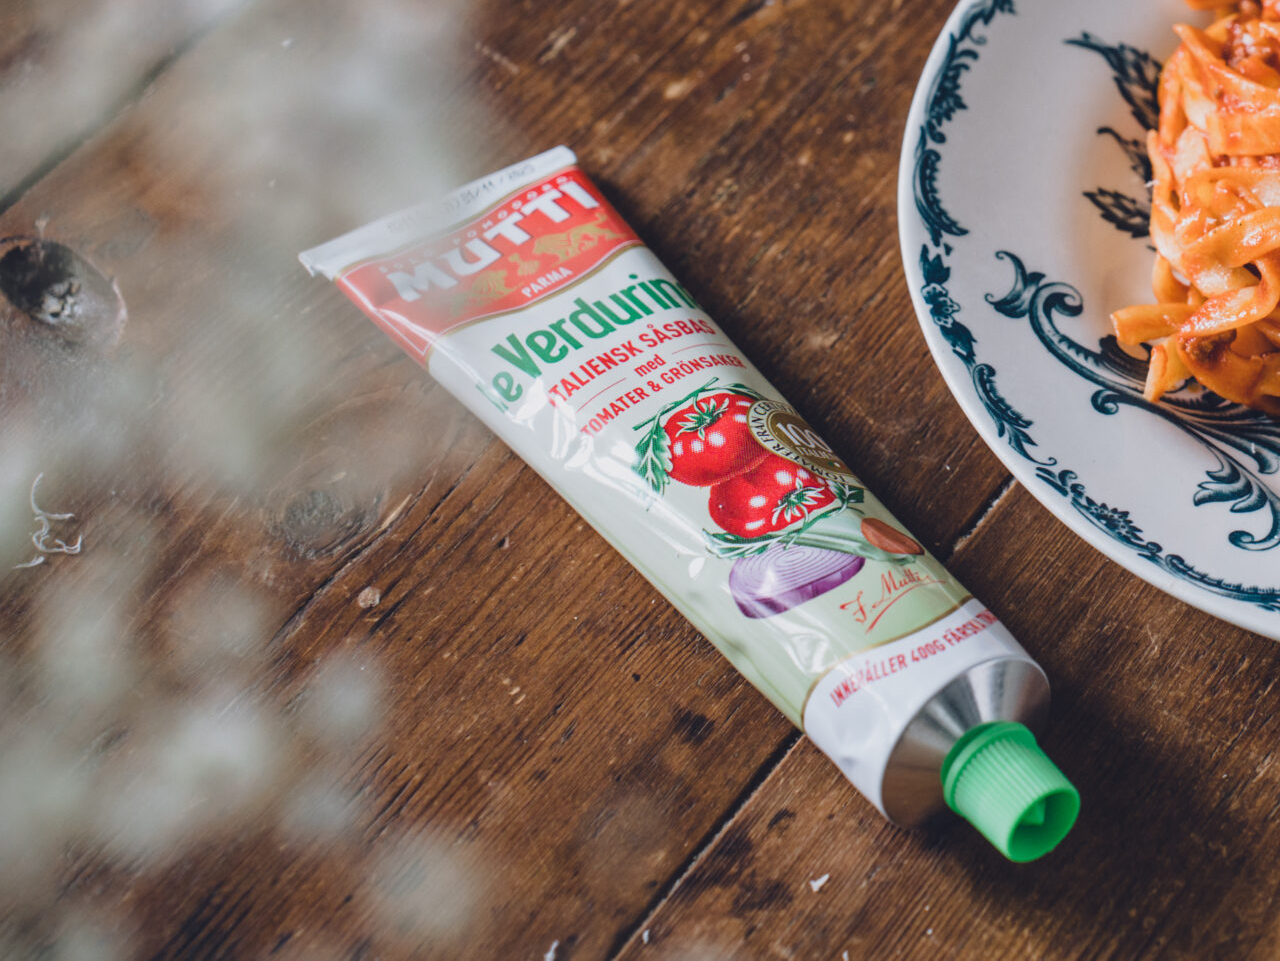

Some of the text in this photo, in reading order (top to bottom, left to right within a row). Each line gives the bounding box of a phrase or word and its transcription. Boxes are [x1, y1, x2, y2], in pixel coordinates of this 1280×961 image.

[386, 180, 600, 302] MUTTI
[521, 266, 574, 298] PARMA
[491, 273, 702, 379] Verdurin
[638, 319, 716, 348] SÅSBAS
[633, 353, 667, 378] med
[580, 354, 747, 438] TOMATER & GRÖNSAKER
[910, 638, 947, 663] 400G
